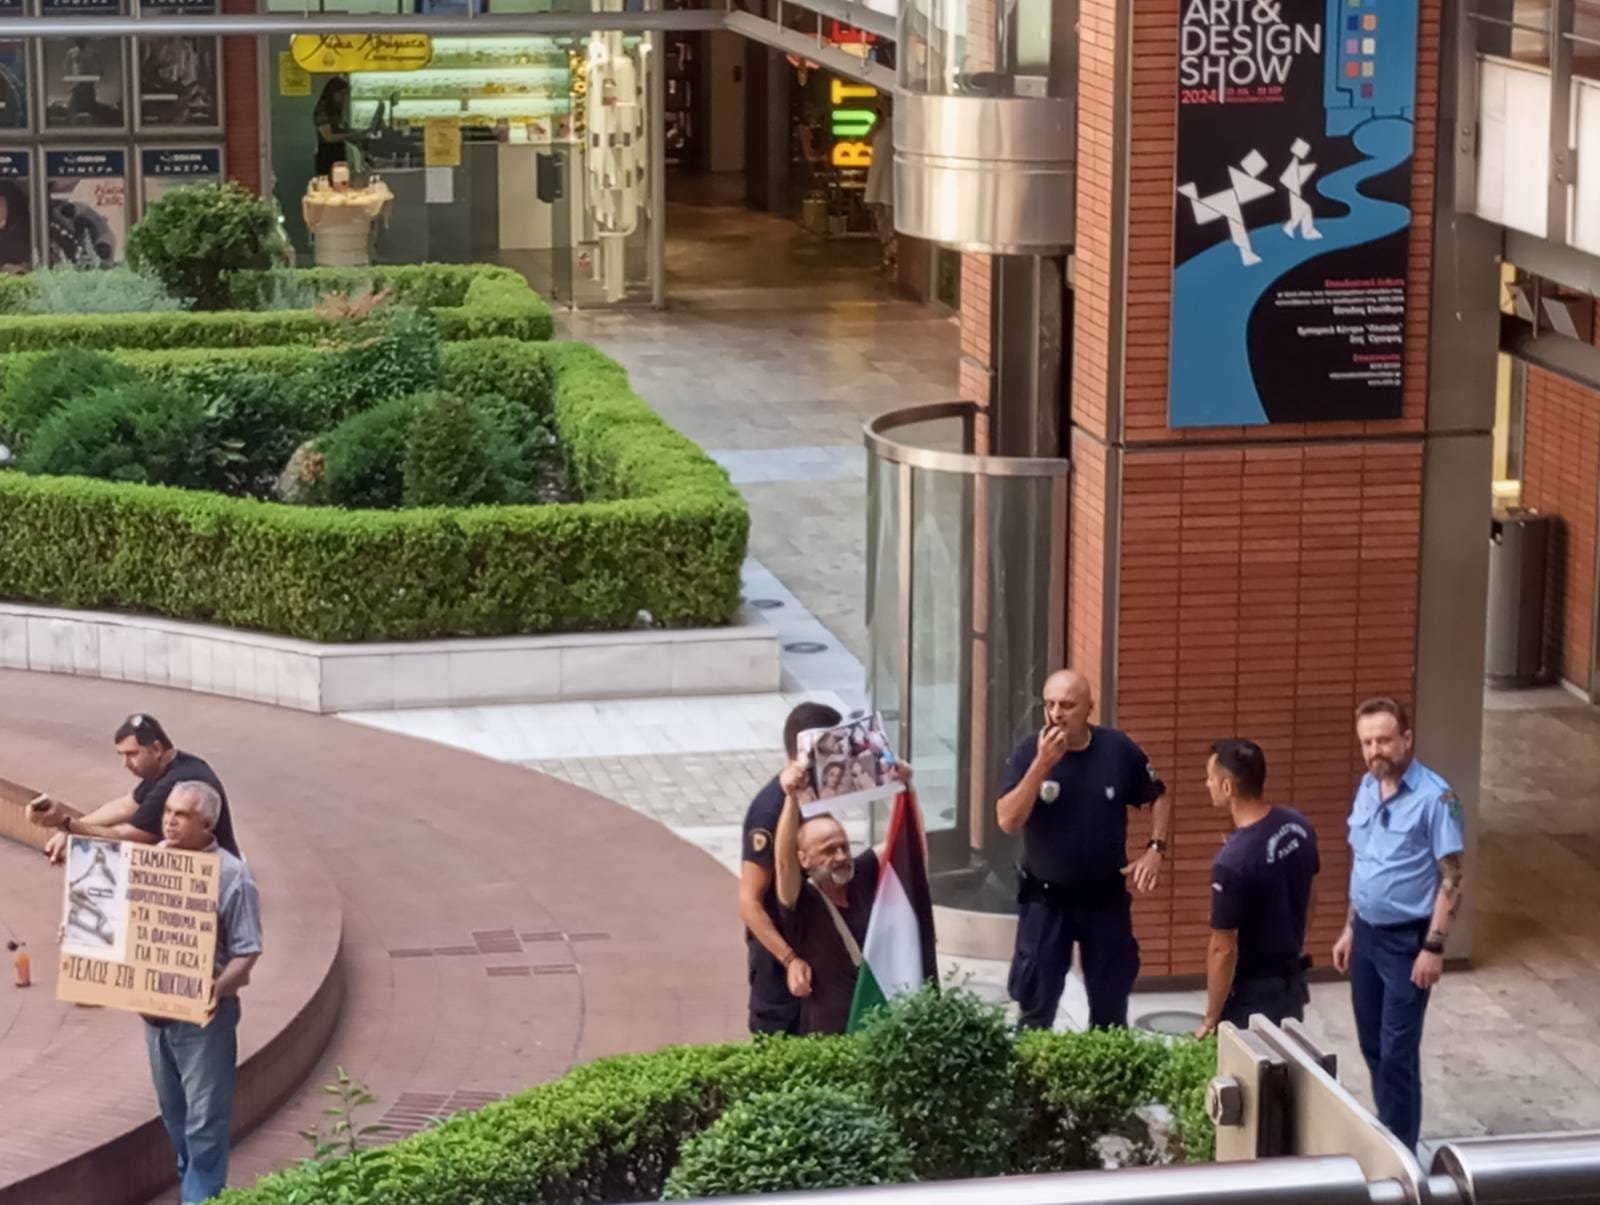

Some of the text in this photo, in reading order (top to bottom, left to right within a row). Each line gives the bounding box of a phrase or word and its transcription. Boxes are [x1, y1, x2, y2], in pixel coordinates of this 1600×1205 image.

[1181, 23, 1321, 56] DESIGN
[1180, 54, 1293, 104] SHOW
[1181, 88, 1218, 104] 2024
